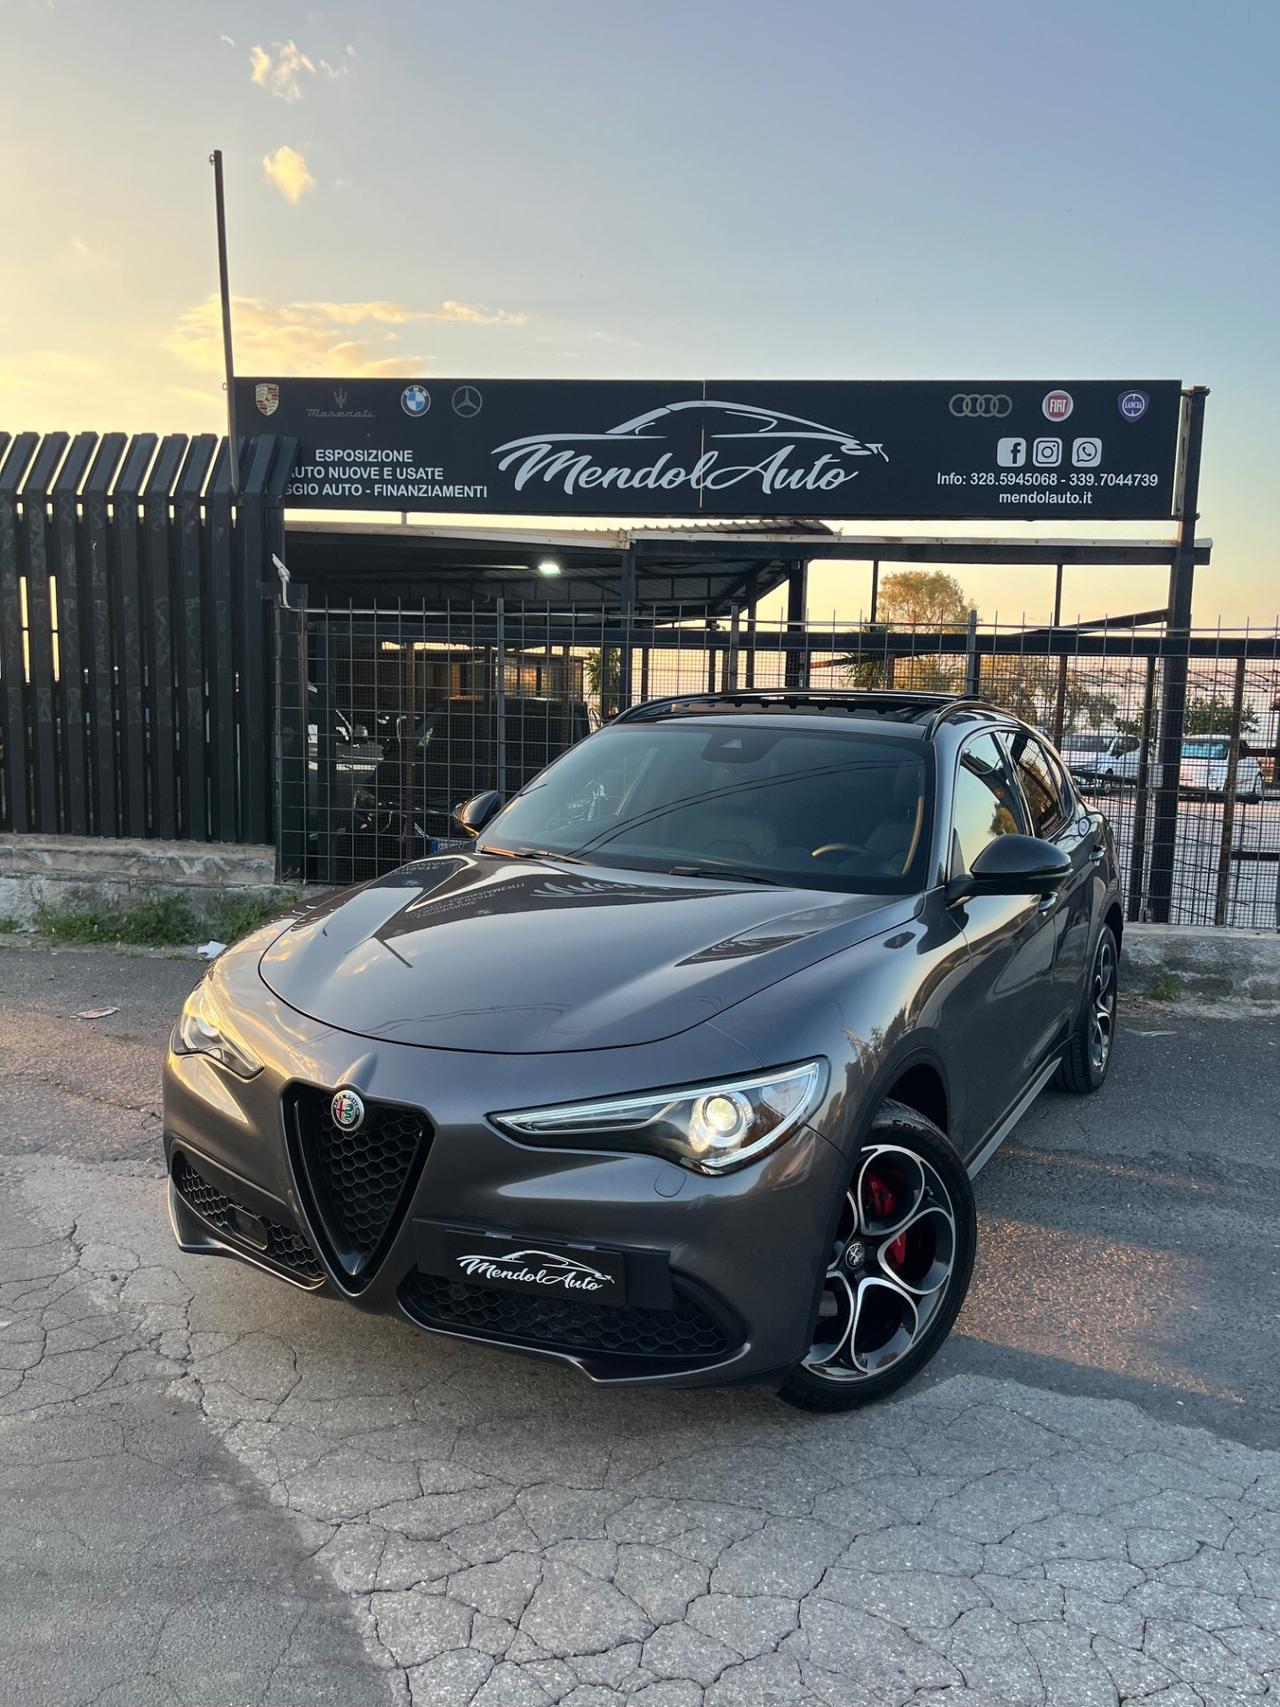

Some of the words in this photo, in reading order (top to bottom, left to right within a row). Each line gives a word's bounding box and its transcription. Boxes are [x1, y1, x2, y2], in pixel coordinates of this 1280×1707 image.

[1049, 399, 1067, 413] FIAT
[315, 449, 413, 462] ESPOSIZIONE
[291, 466, 325, 479] UTO
[329, 466, 380, 479] NUOVE
[384, 467, 393, 479] E
[396, 467, 443, 480] USATE
[936, 472, 967, 486] Info:
[970, 472, 1058, 486] 328.5945068
[1069, 473, 1158, 487] 339.7044739
[322, 484, 362, 496] AUTO
[374, 484, 488, 498] FINANZIAMENTI
[999, 491, 1093, 504] mendolauto.it
